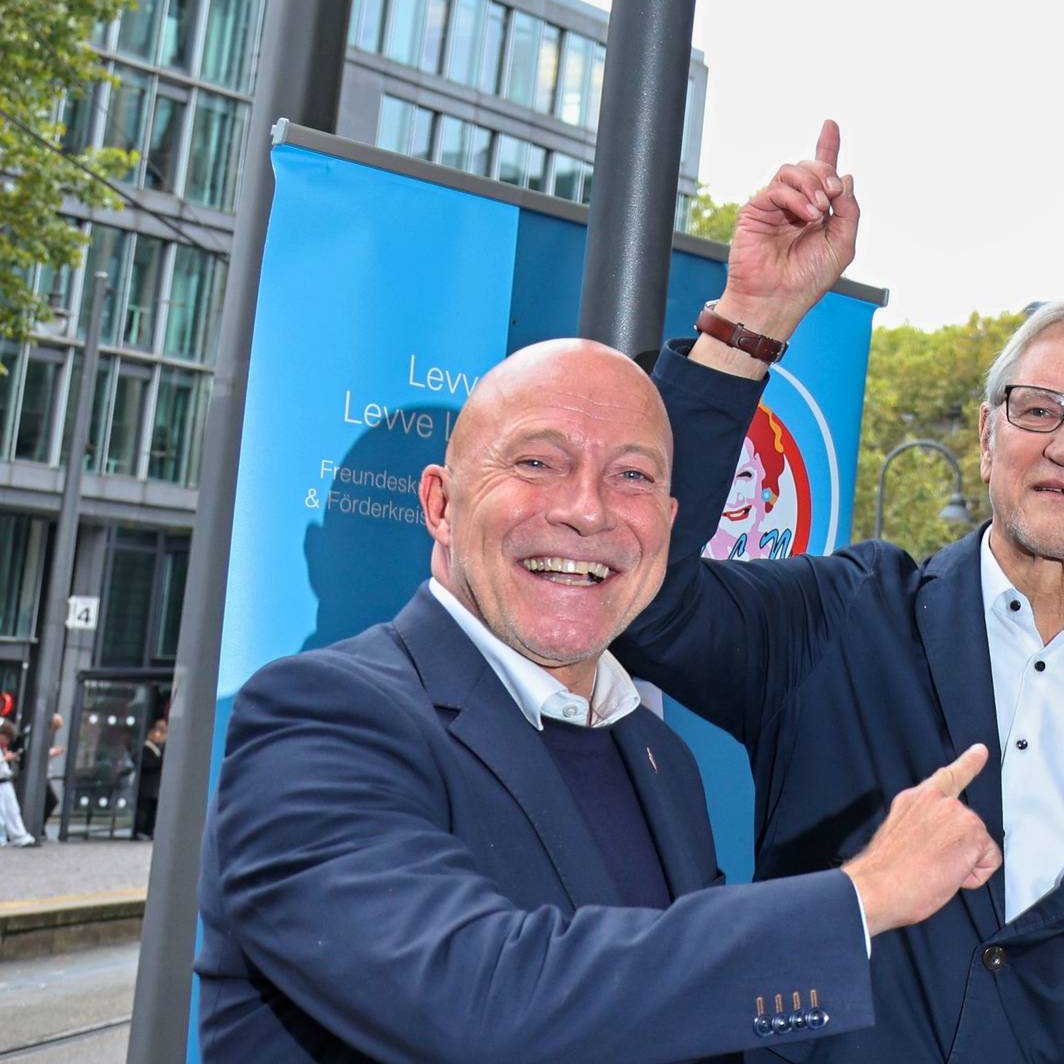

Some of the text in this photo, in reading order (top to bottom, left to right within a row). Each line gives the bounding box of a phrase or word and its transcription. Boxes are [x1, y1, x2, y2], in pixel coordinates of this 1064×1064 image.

[409, 354, 479, 397] Levv
[344, 390, 434, 438] Levve
[320, 459, 420, 494] Freundesk
[304, 488, 427, 526] & Förderkreis
[77, 607, 90, 623] 4
